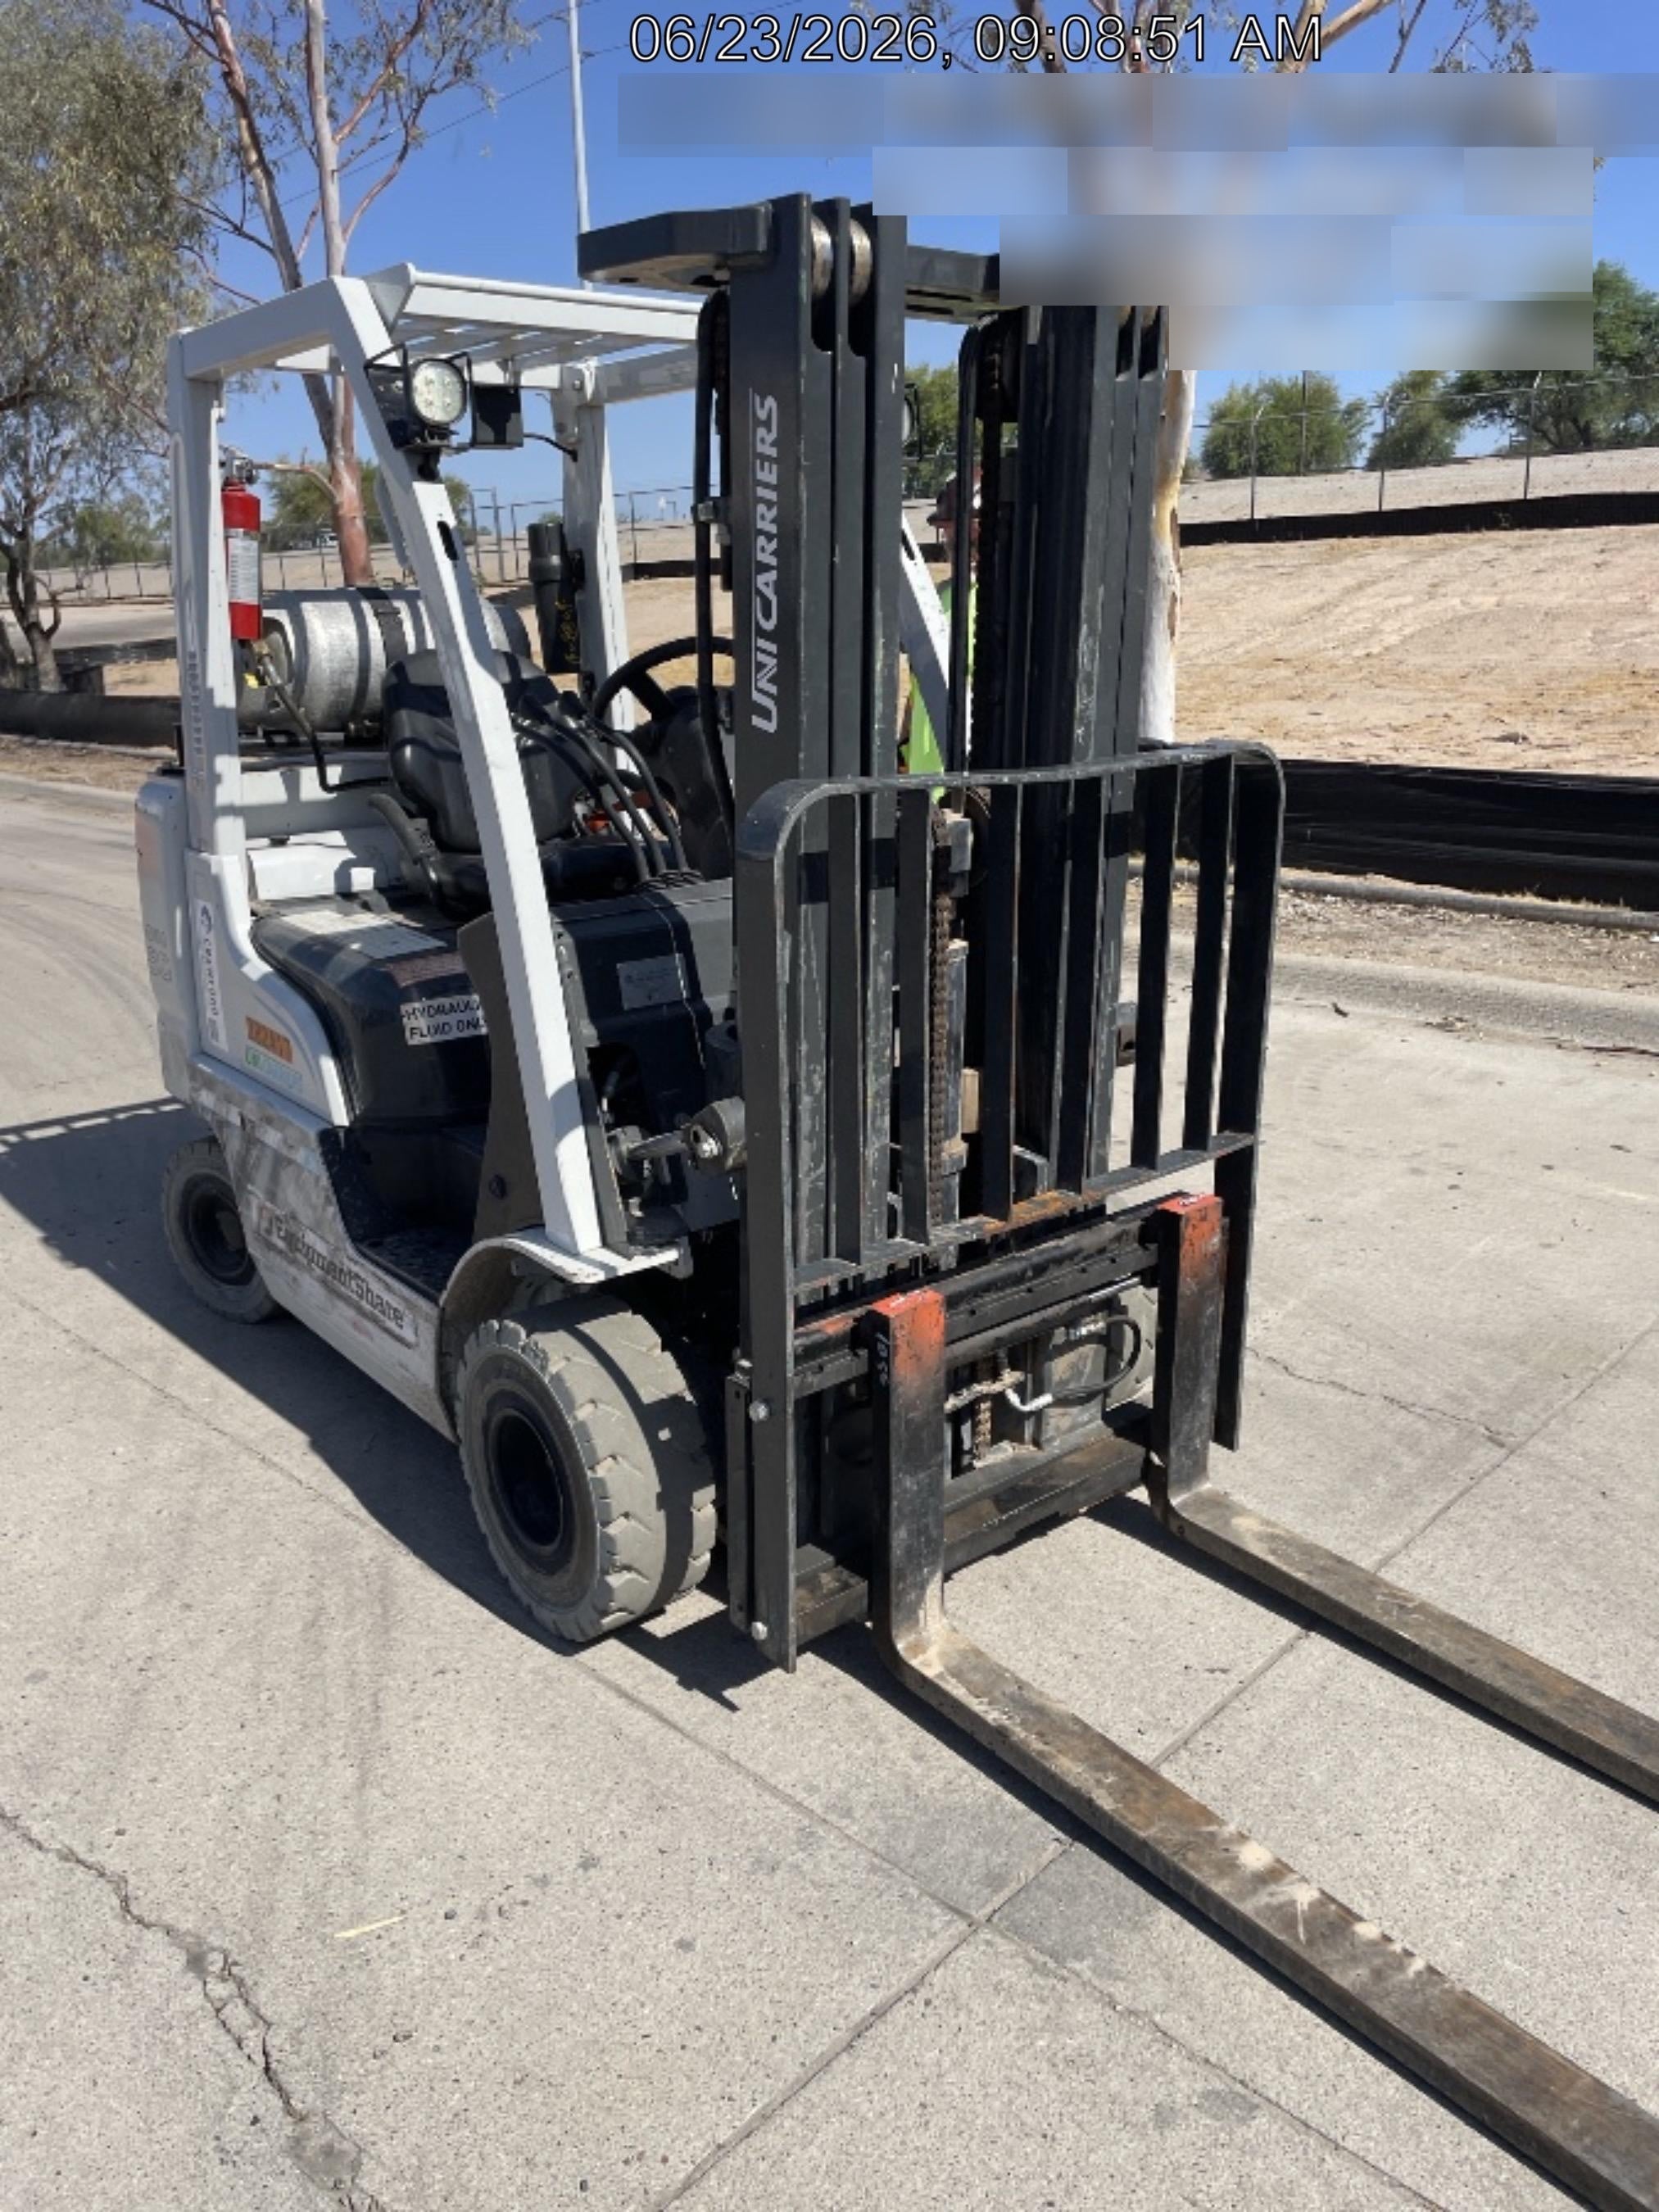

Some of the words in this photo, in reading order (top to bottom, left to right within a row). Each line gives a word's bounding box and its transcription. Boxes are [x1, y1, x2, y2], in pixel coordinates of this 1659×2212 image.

[750, 393, 778, 734] UNICARRIERS
[404, 999, 481, 1021] HYDRAULI
[410, 1022, 452, 1040] FLUID
[456, 1017, 485, 1033] ONL
